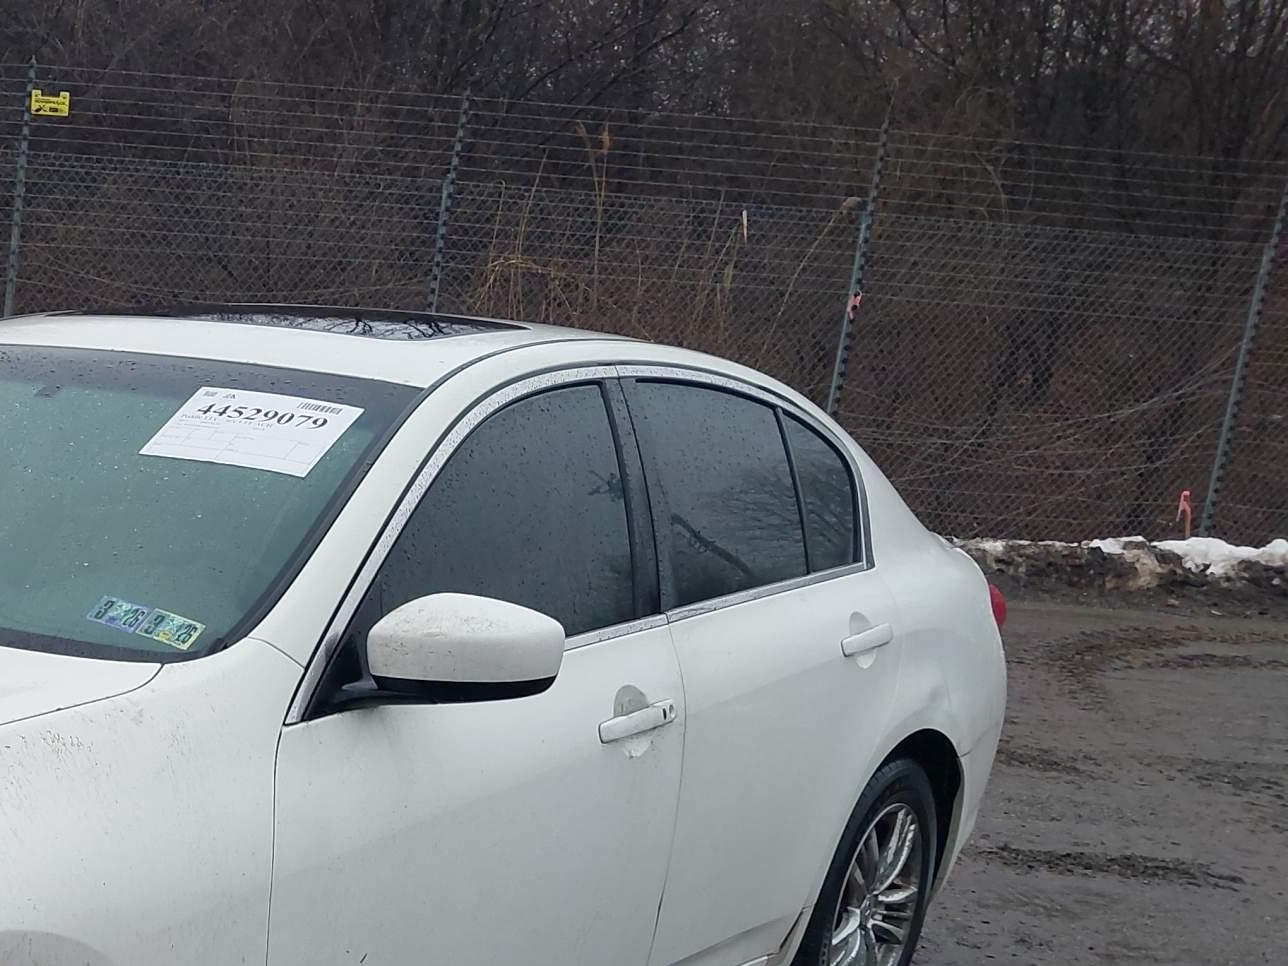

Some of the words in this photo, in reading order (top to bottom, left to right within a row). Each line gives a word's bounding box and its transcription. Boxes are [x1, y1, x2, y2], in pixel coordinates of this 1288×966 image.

[197, 402, 329, 431] 44529079
[94, 599, 115, 620] 3
[144, 614, 165, 634] 3
